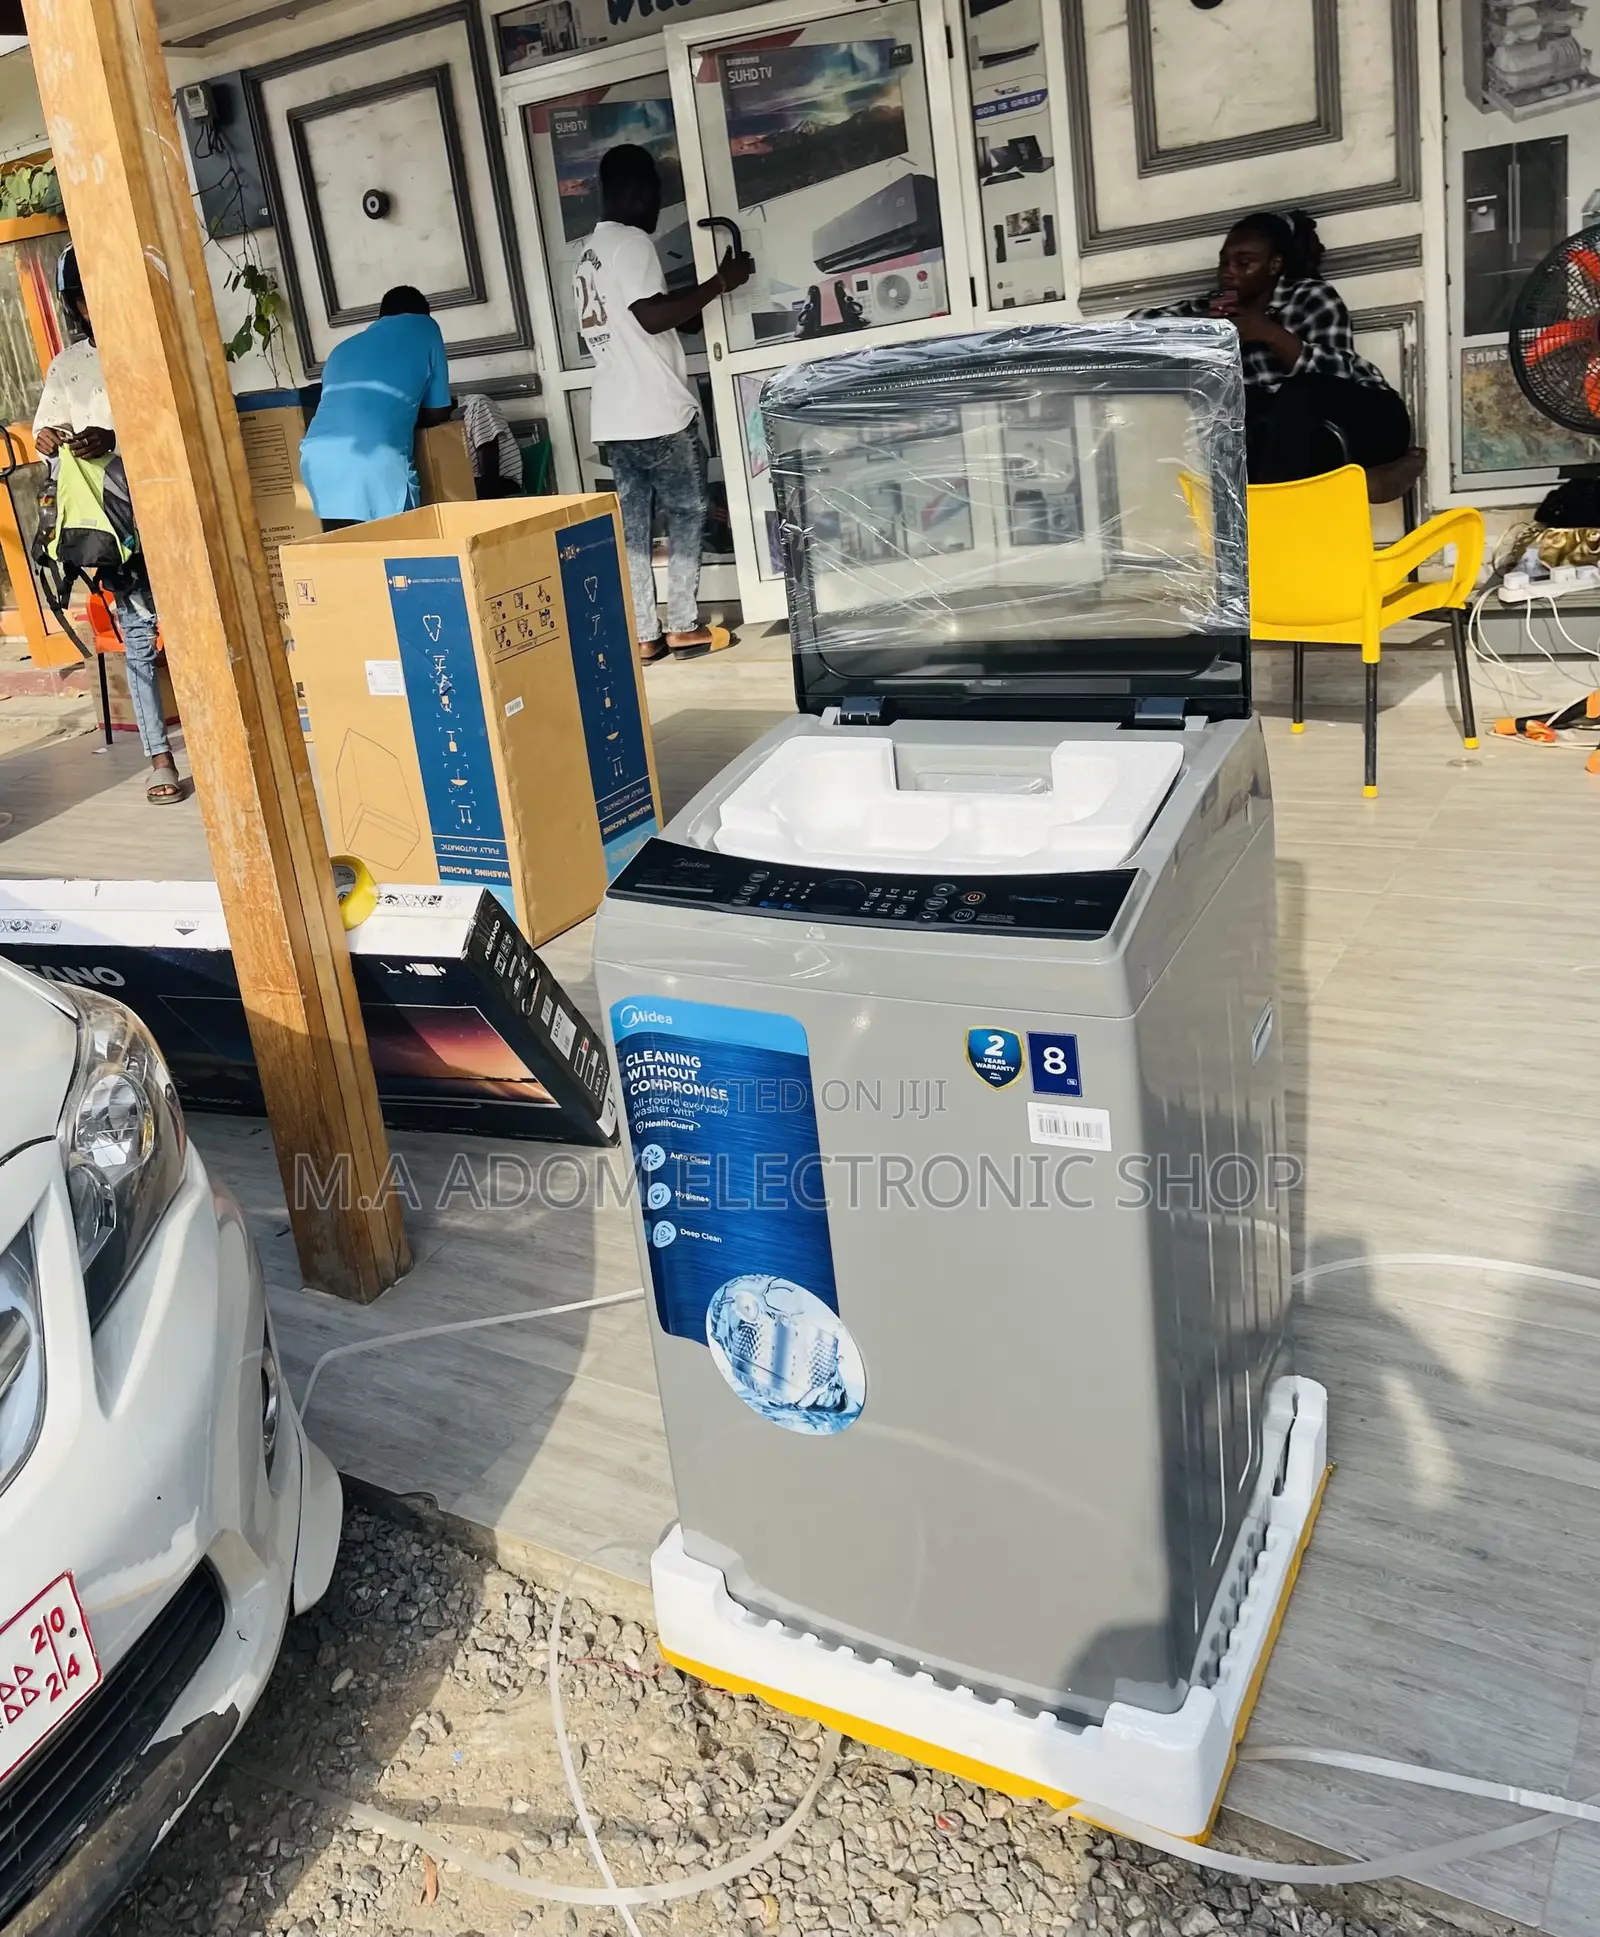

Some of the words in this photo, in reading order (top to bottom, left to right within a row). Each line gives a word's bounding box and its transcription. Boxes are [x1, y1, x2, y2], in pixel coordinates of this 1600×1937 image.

[727, 69, 760, 84] SUHD
[759, 65, 773, 79] TV
[975, 104, 997, 116] GOD
[997, 101, 1008, 111] IS
[1010, 93, 1042, 108] GREAT
[555, 121, 578, 134] SUHD
[577, 119, 587, 131] TV
[1466, 349, 1509, 364] SAMS
[627, 804, 652, 821] WASHING
[602, 817, 627, 835] MACHINE
[440, 843, 478, 853] AUTOMATIC
[479, 846, 500, 855] FULLY
[439, 865, 472, 876] MACHINE
[474, 868, 510, 879] WASHING
[174, 919, 201, 928] FRONT
[485, 919, 501, 961] ASANO
[620, 1004, 673, 1028] Midea
[984, 1034, 1005, 1057] 2
[625, 1050, 702, 1068] CLEANING
[983, 1057, 1007, 1066] YEARS
[1043, 1046, 1067, 1075] 8
[628, 1064, 698, 1081] WITHOUT
[975, 1062, 1015, 1073] WARRANTY
[630, 1078, 729, 1101] COMPROMISE
[633, 1097, 680, 1111] All-round
[682, 1100, 729, 1117] everyday
[633, 1104, 670, 1119] washer
[672, 1107, 695, 1117] with
[644, 1119, 694, 1131] HealthGuard
[670, 1152, 689, 1162] Auto
[689, 1155, 711, 1166] Clean
[675, 1190, 710, 1203] Hygiene+
[680, 1228, 701, 1239] Deep
[701, 1232, 723, 1244] Clean
